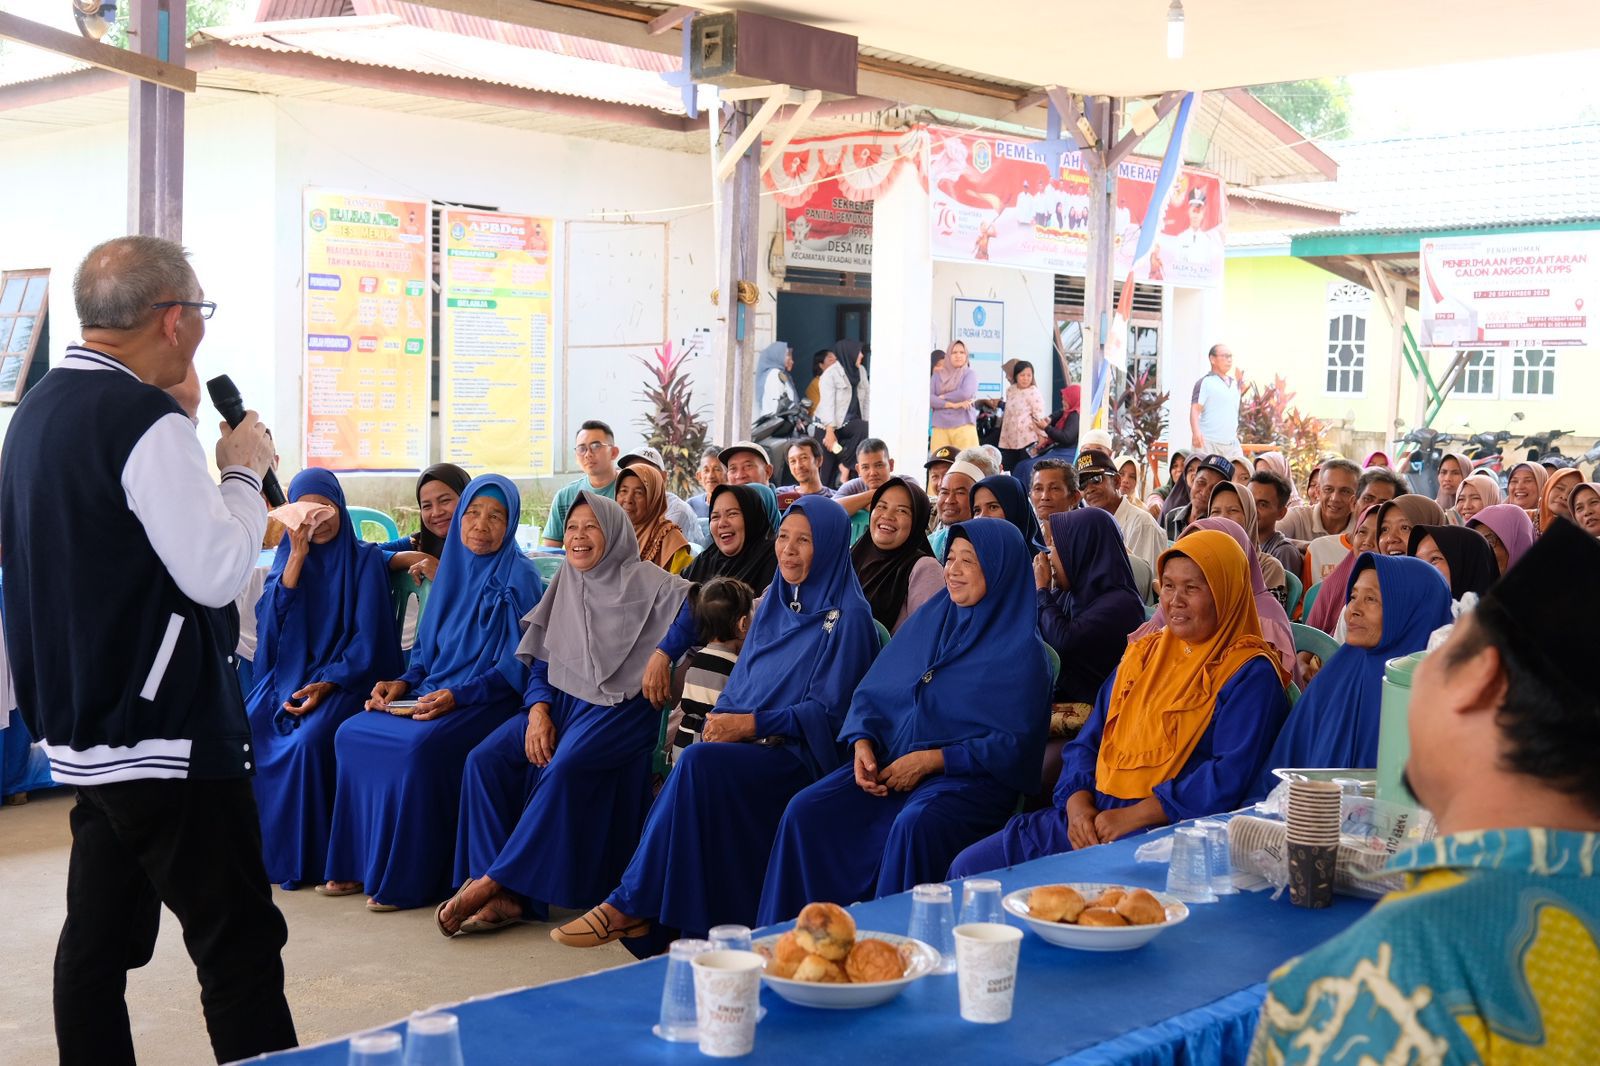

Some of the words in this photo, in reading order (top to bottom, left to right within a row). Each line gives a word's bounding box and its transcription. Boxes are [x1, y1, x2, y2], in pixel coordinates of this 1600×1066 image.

[1119, 164, 1159, 182] MERAP
[805, 208, 834, 220] PANITIA
[837, 212, 873, 225] PEMUNGU
[469, 221, 526, 236] APBDes
[828, 240, 853, 254] DESA
[1486, 246, 1540, 255] PENGUMUMAN
[791, 251, 825, 262] KECAMATAN
[827, 255, 852, 265] SEKADAU
[1443, 257, 1507, 268] PENERIMAAN
[1510, 254, 1588, 265] PENDAFTARAN
[1455, 267, 1489, 278] CALON
[1492, 266, 1543, 276] ANGGOTA
[1546, 264, 1572, 274] KPPS
[1215, 457, 1231, 474] NBA
[1385, 837, 1400, 855] CUP
[718, 1004, 746, 1014] ENJOY
[709, 1010, 743, 1024] ENJOY
